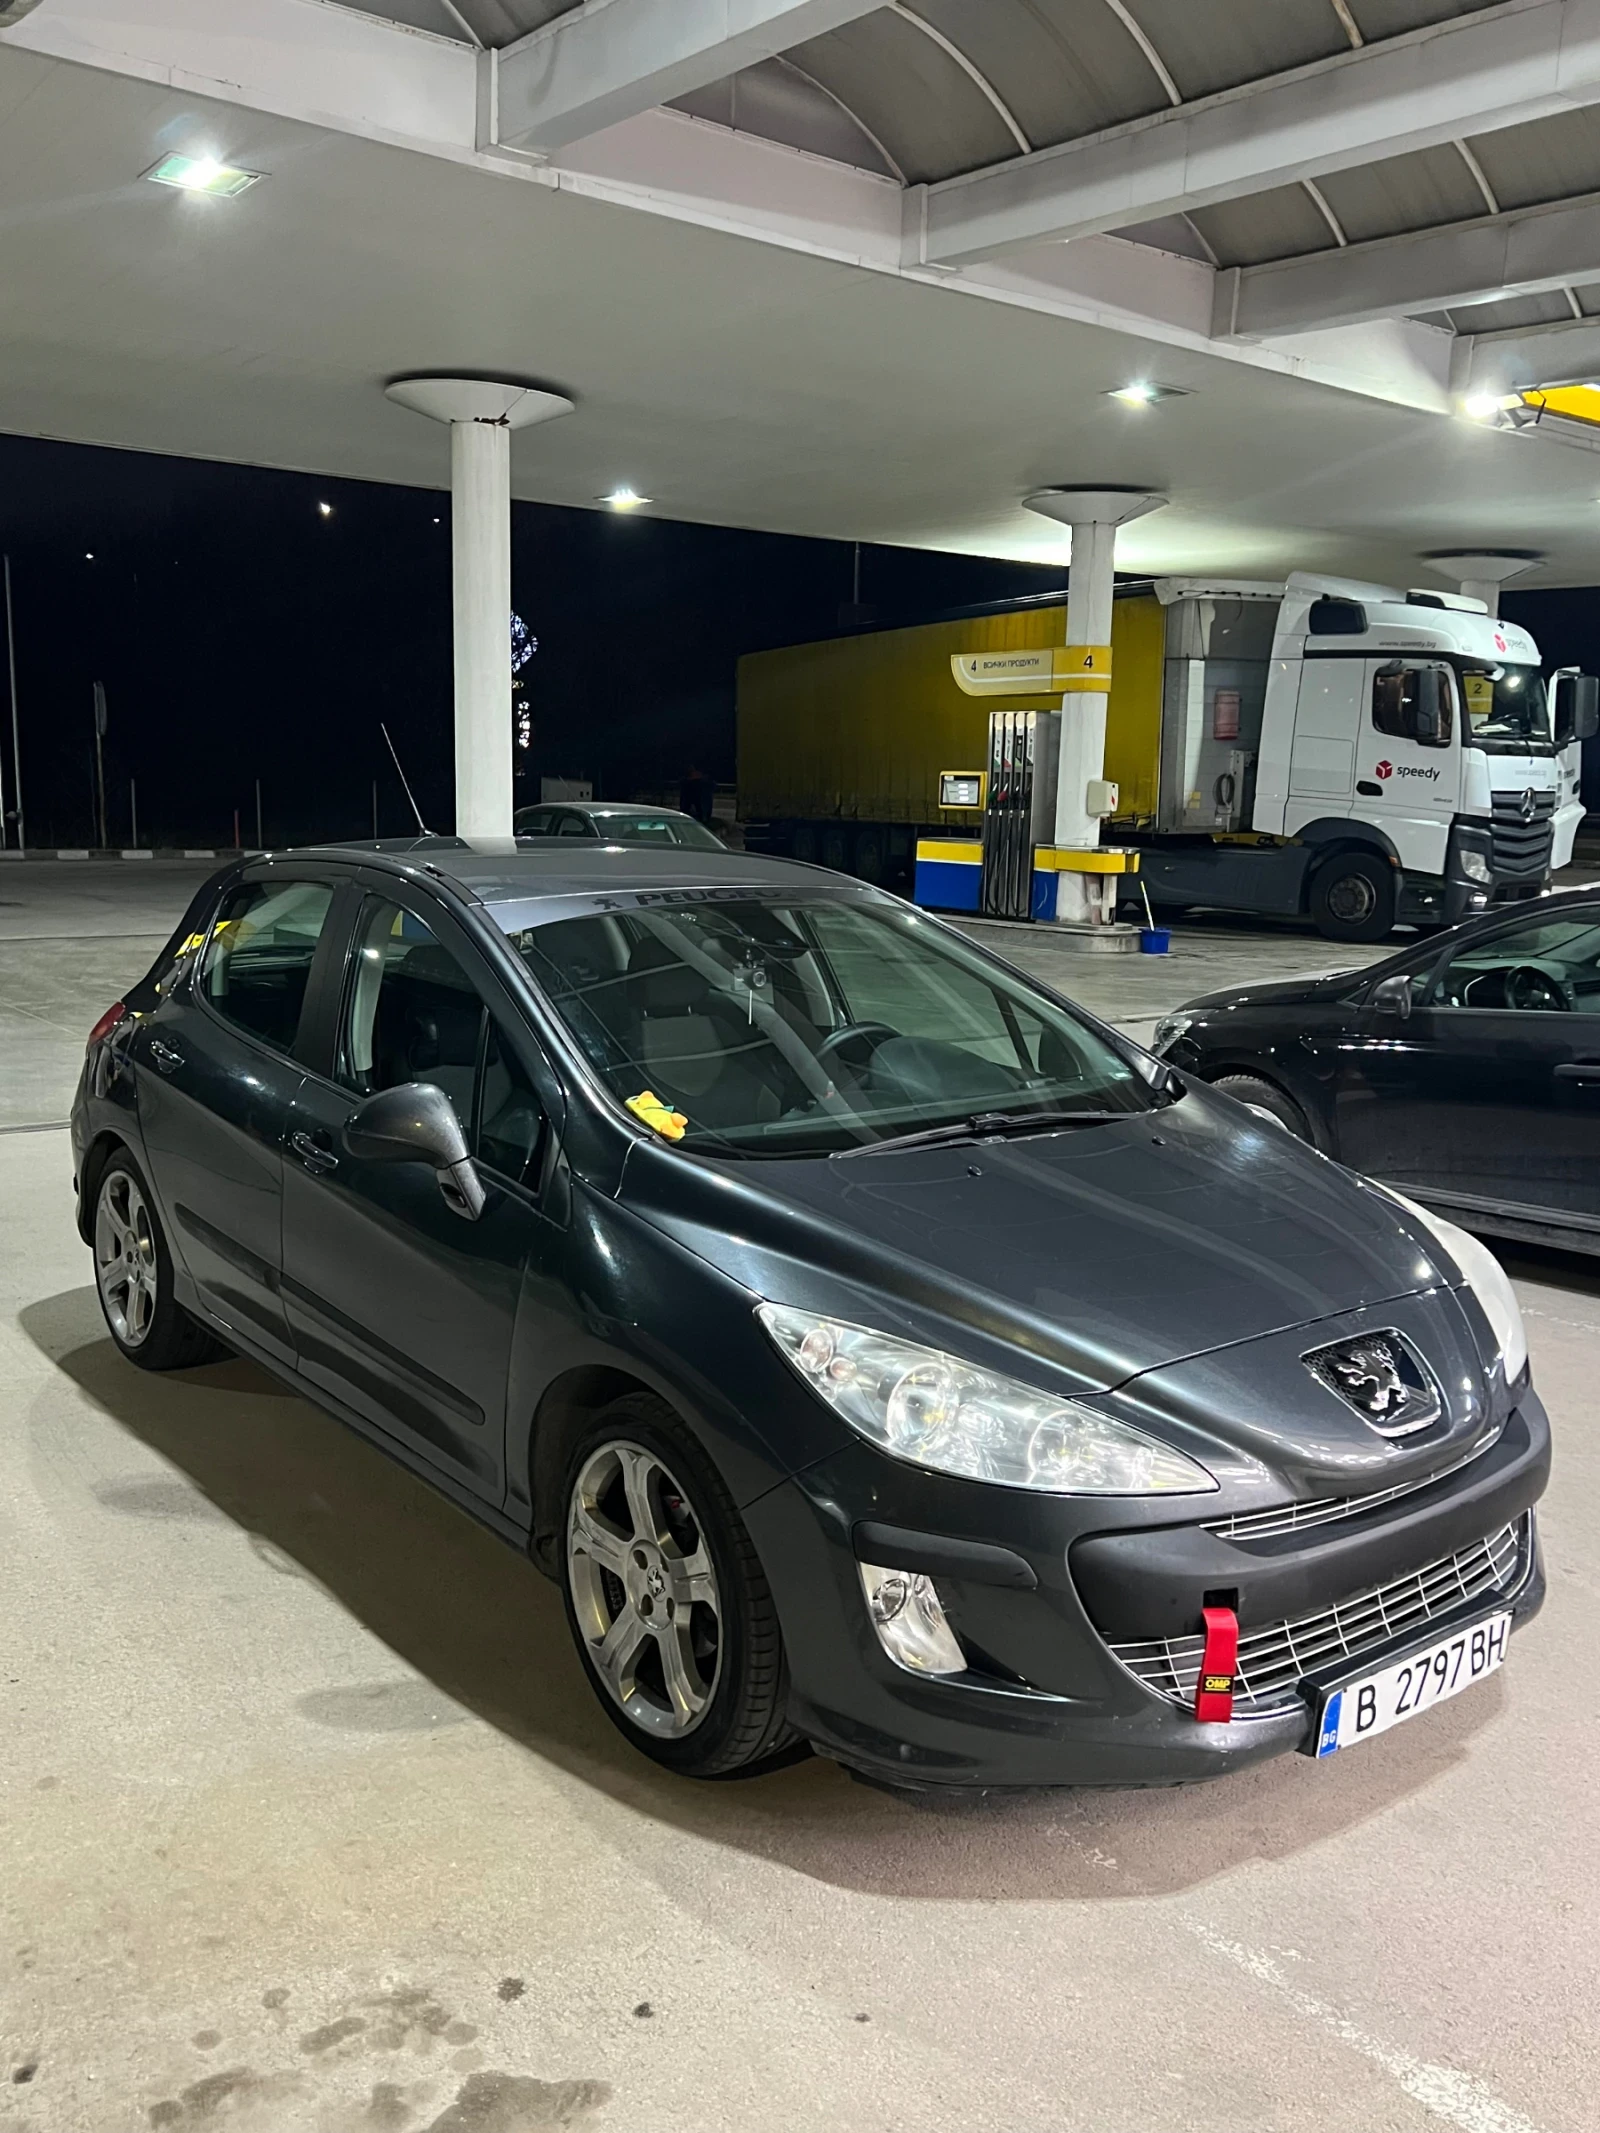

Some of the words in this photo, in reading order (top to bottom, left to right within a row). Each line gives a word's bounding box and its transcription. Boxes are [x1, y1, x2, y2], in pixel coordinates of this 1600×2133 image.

[970, 659, 977, 672] 4
[1083, 655, 1094, 669] 4
[1474, 682, 1483, 695] 2
[1396, 766, 1441, 782] speedy
[634, 888, 790, 906] PEUGEO
[1356, 1684, 1377, 1733] B
[1395, 1638, 1466, 1715] 2797
[1471, 1619, 1506, 1677] BH
[1205, 1679, 1231, 1689] OMP
[1321, 1730, 1337, 1748] BG
